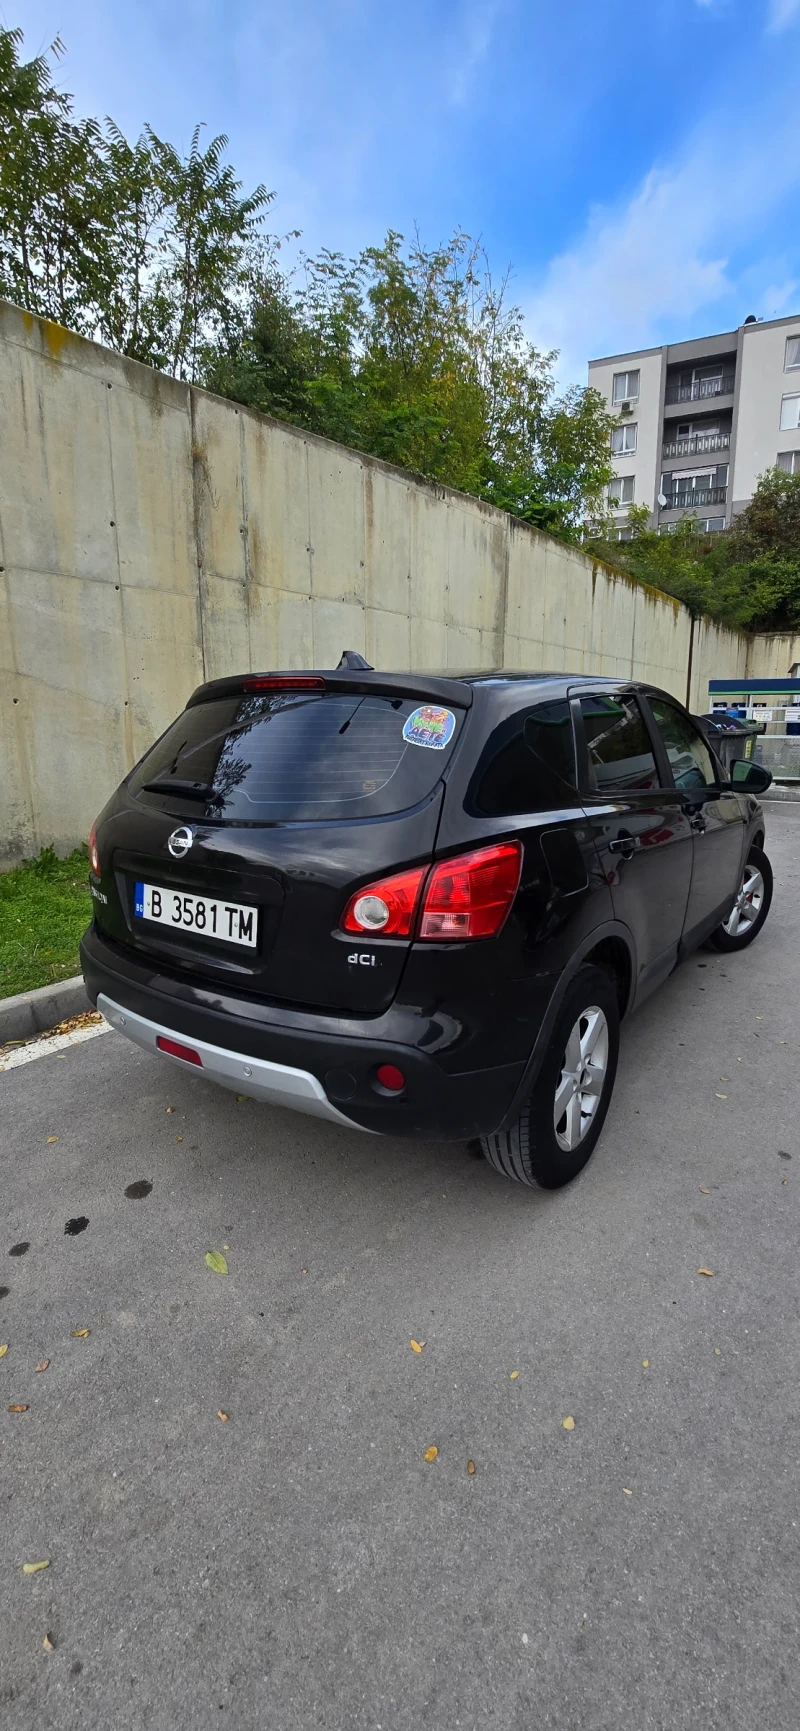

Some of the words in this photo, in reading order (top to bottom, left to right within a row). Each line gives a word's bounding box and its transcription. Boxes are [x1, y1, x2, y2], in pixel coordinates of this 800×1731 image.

[136, 903, 143, 912] BG
[151, 889, 162, 918] B
[171, 895, 217, 933] 3581
[224, 906, 253, 942] TM
